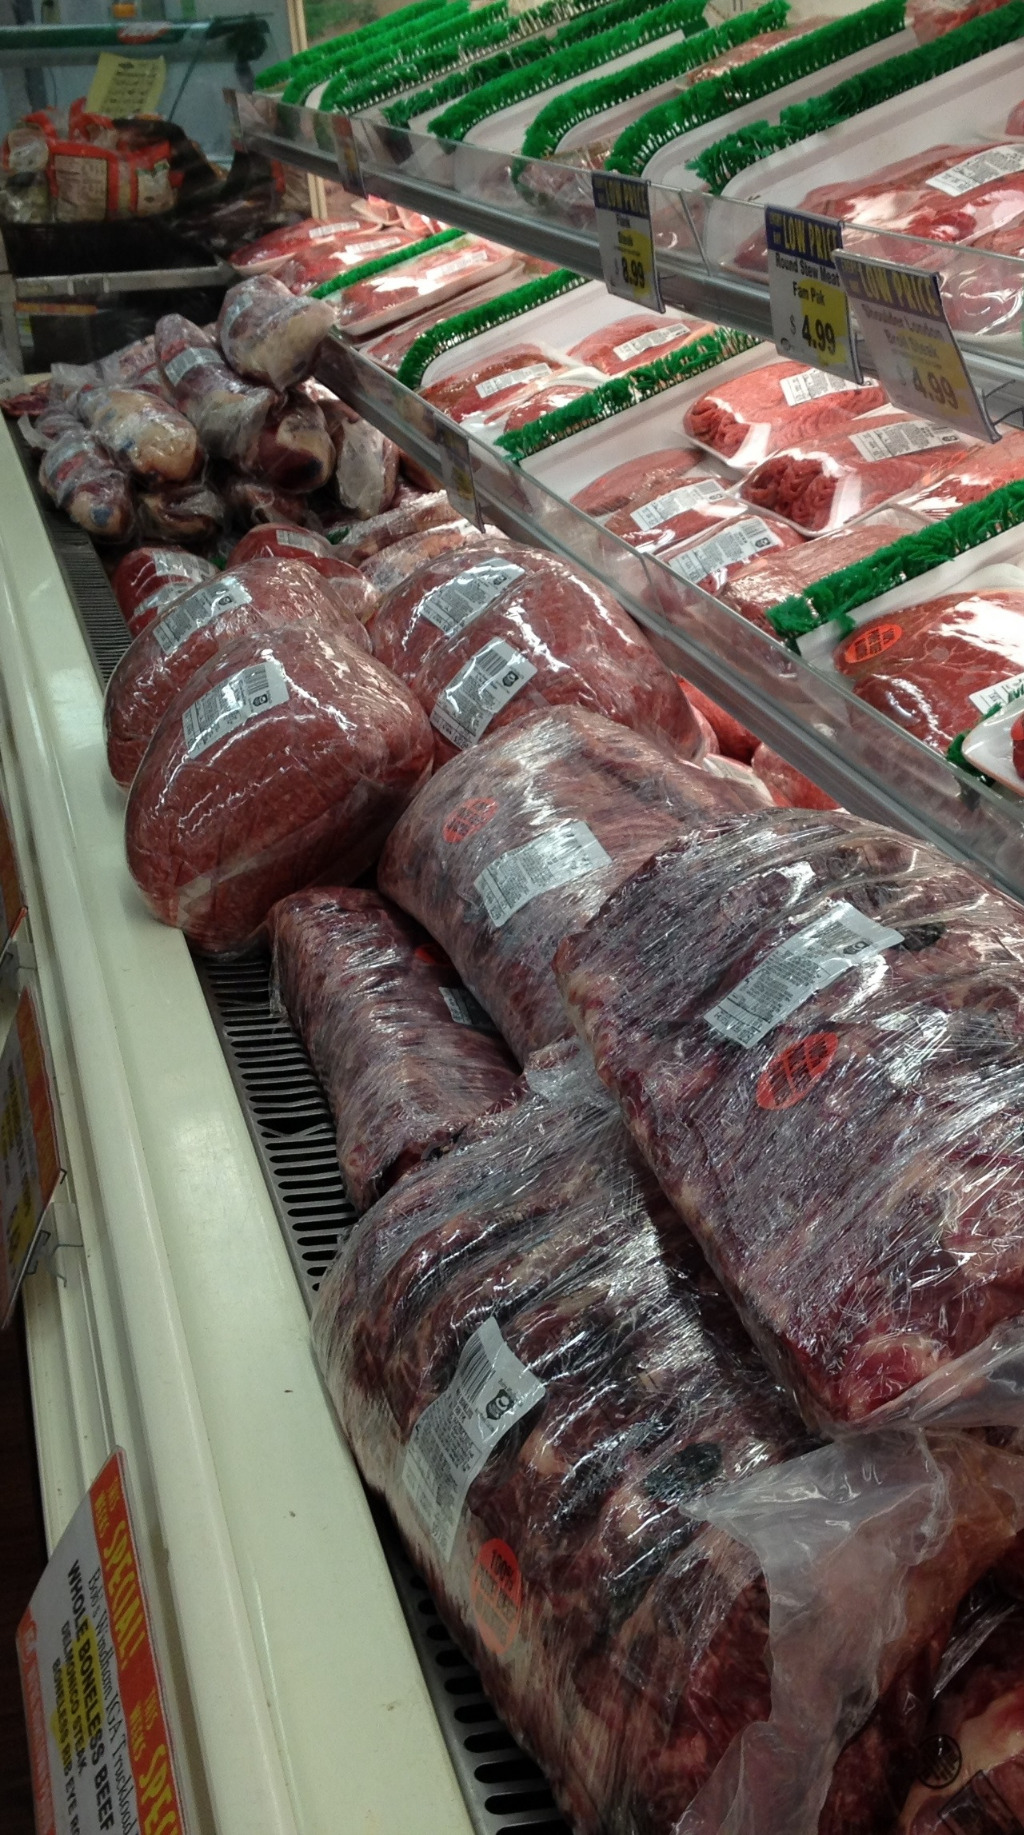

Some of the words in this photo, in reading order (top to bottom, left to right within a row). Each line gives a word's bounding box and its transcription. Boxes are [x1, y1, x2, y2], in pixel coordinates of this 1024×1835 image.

[783, 215, 806, 252] LOW
[775, 252, 798, 273] Round
[800, 260, 818, 279] Stew
[792, 281, 809, 301] Fam
[811, 287, 825, 306] Pak
[859, 263, 893, 303] LOW
[892, 269, 940, 317] PRICE
[802, 315, 836, 355] 4.99
[913, 365, 958, 409] 4.99
[68, 1559, 89, 1642] WHOLE
[103, 1520, 146, 1671] SPECIAL!
[61, 1620, 80, 1714] DELMONICO
[78, 1639, 106, 1766] BONELESS
[106, 1693, 123, 1743] IGA
[52, 1658, 70, 1745] BONELESS
[65, 1777, 77, 1816] EYE
[94, 1764, 115, 1831] BEEF
[112, 1733, 138, 1835] Truckload
